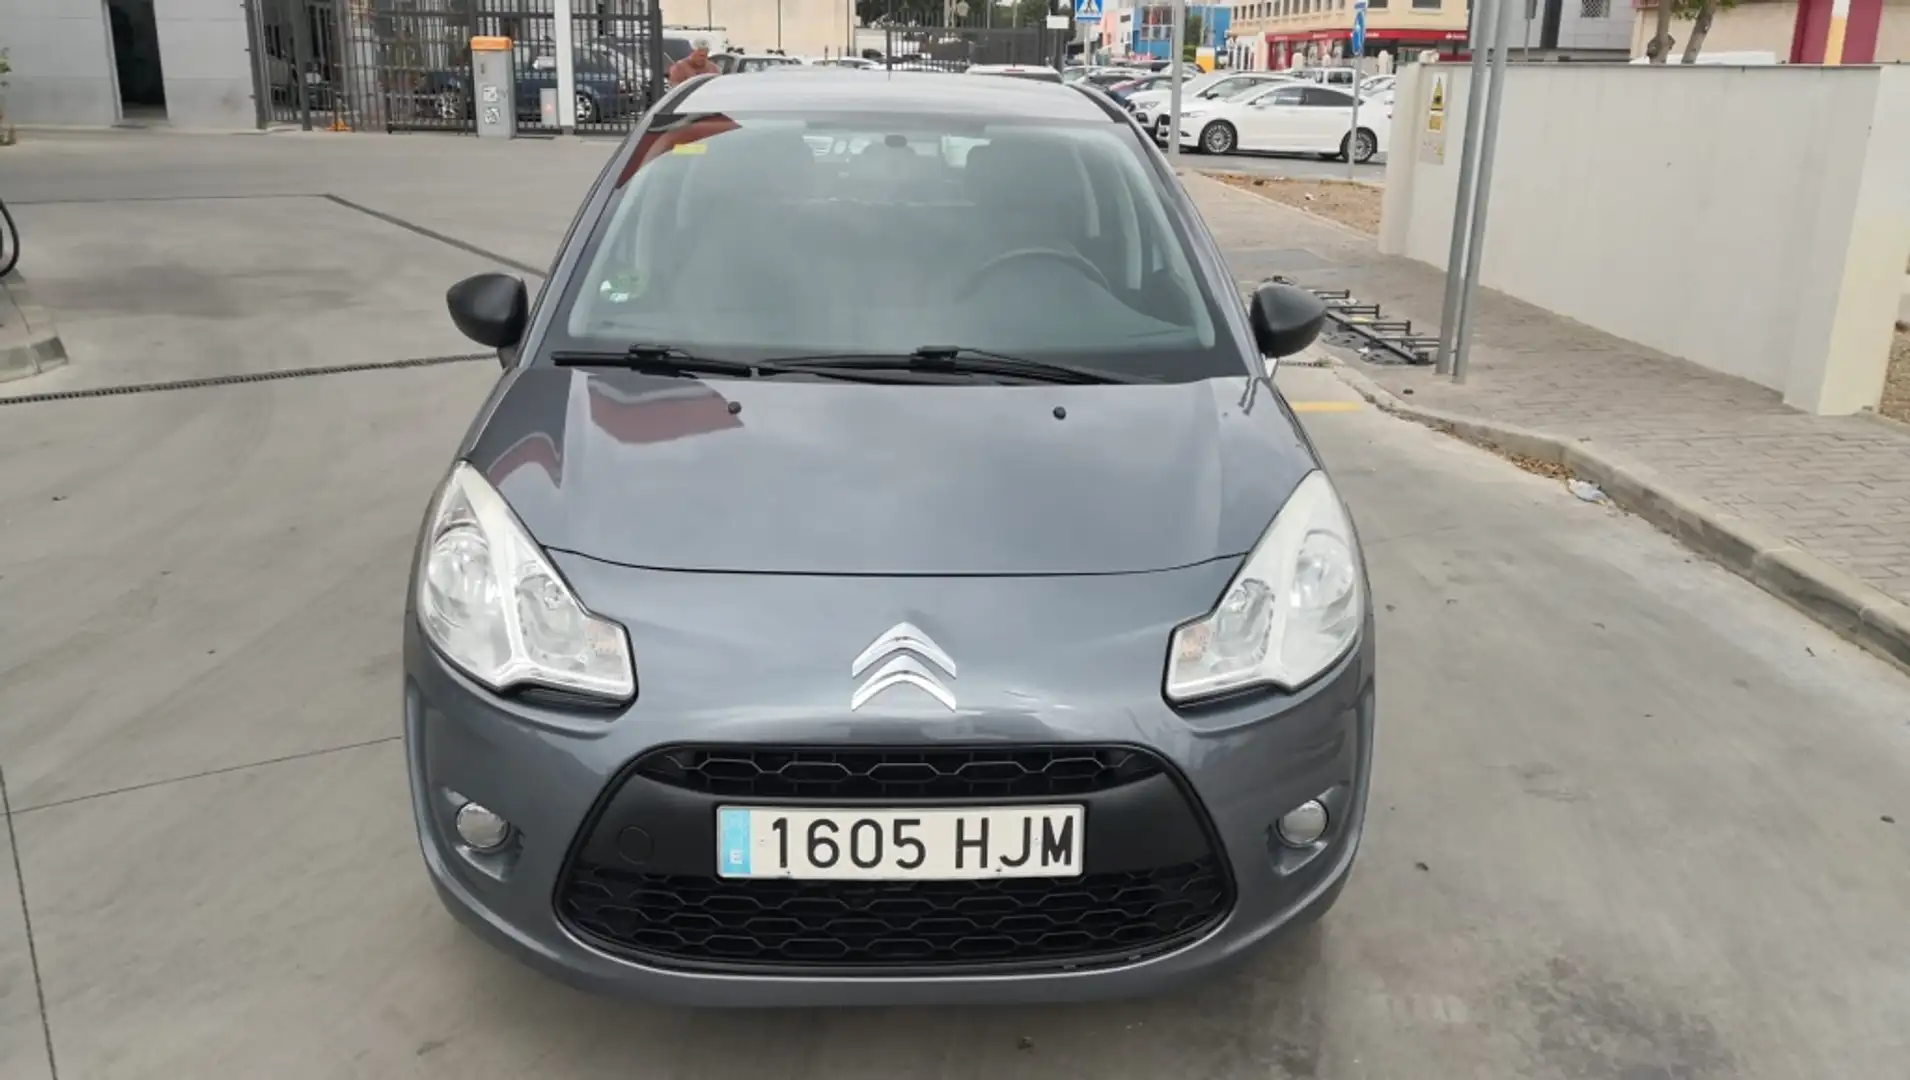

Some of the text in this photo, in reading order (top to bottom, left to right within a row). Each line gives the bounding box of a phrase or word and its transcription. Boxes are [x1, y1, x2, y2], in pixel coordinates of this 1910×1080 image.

[729, 849, 743, 865] E
[772, 816, 1074, 869] 1605 HJM
